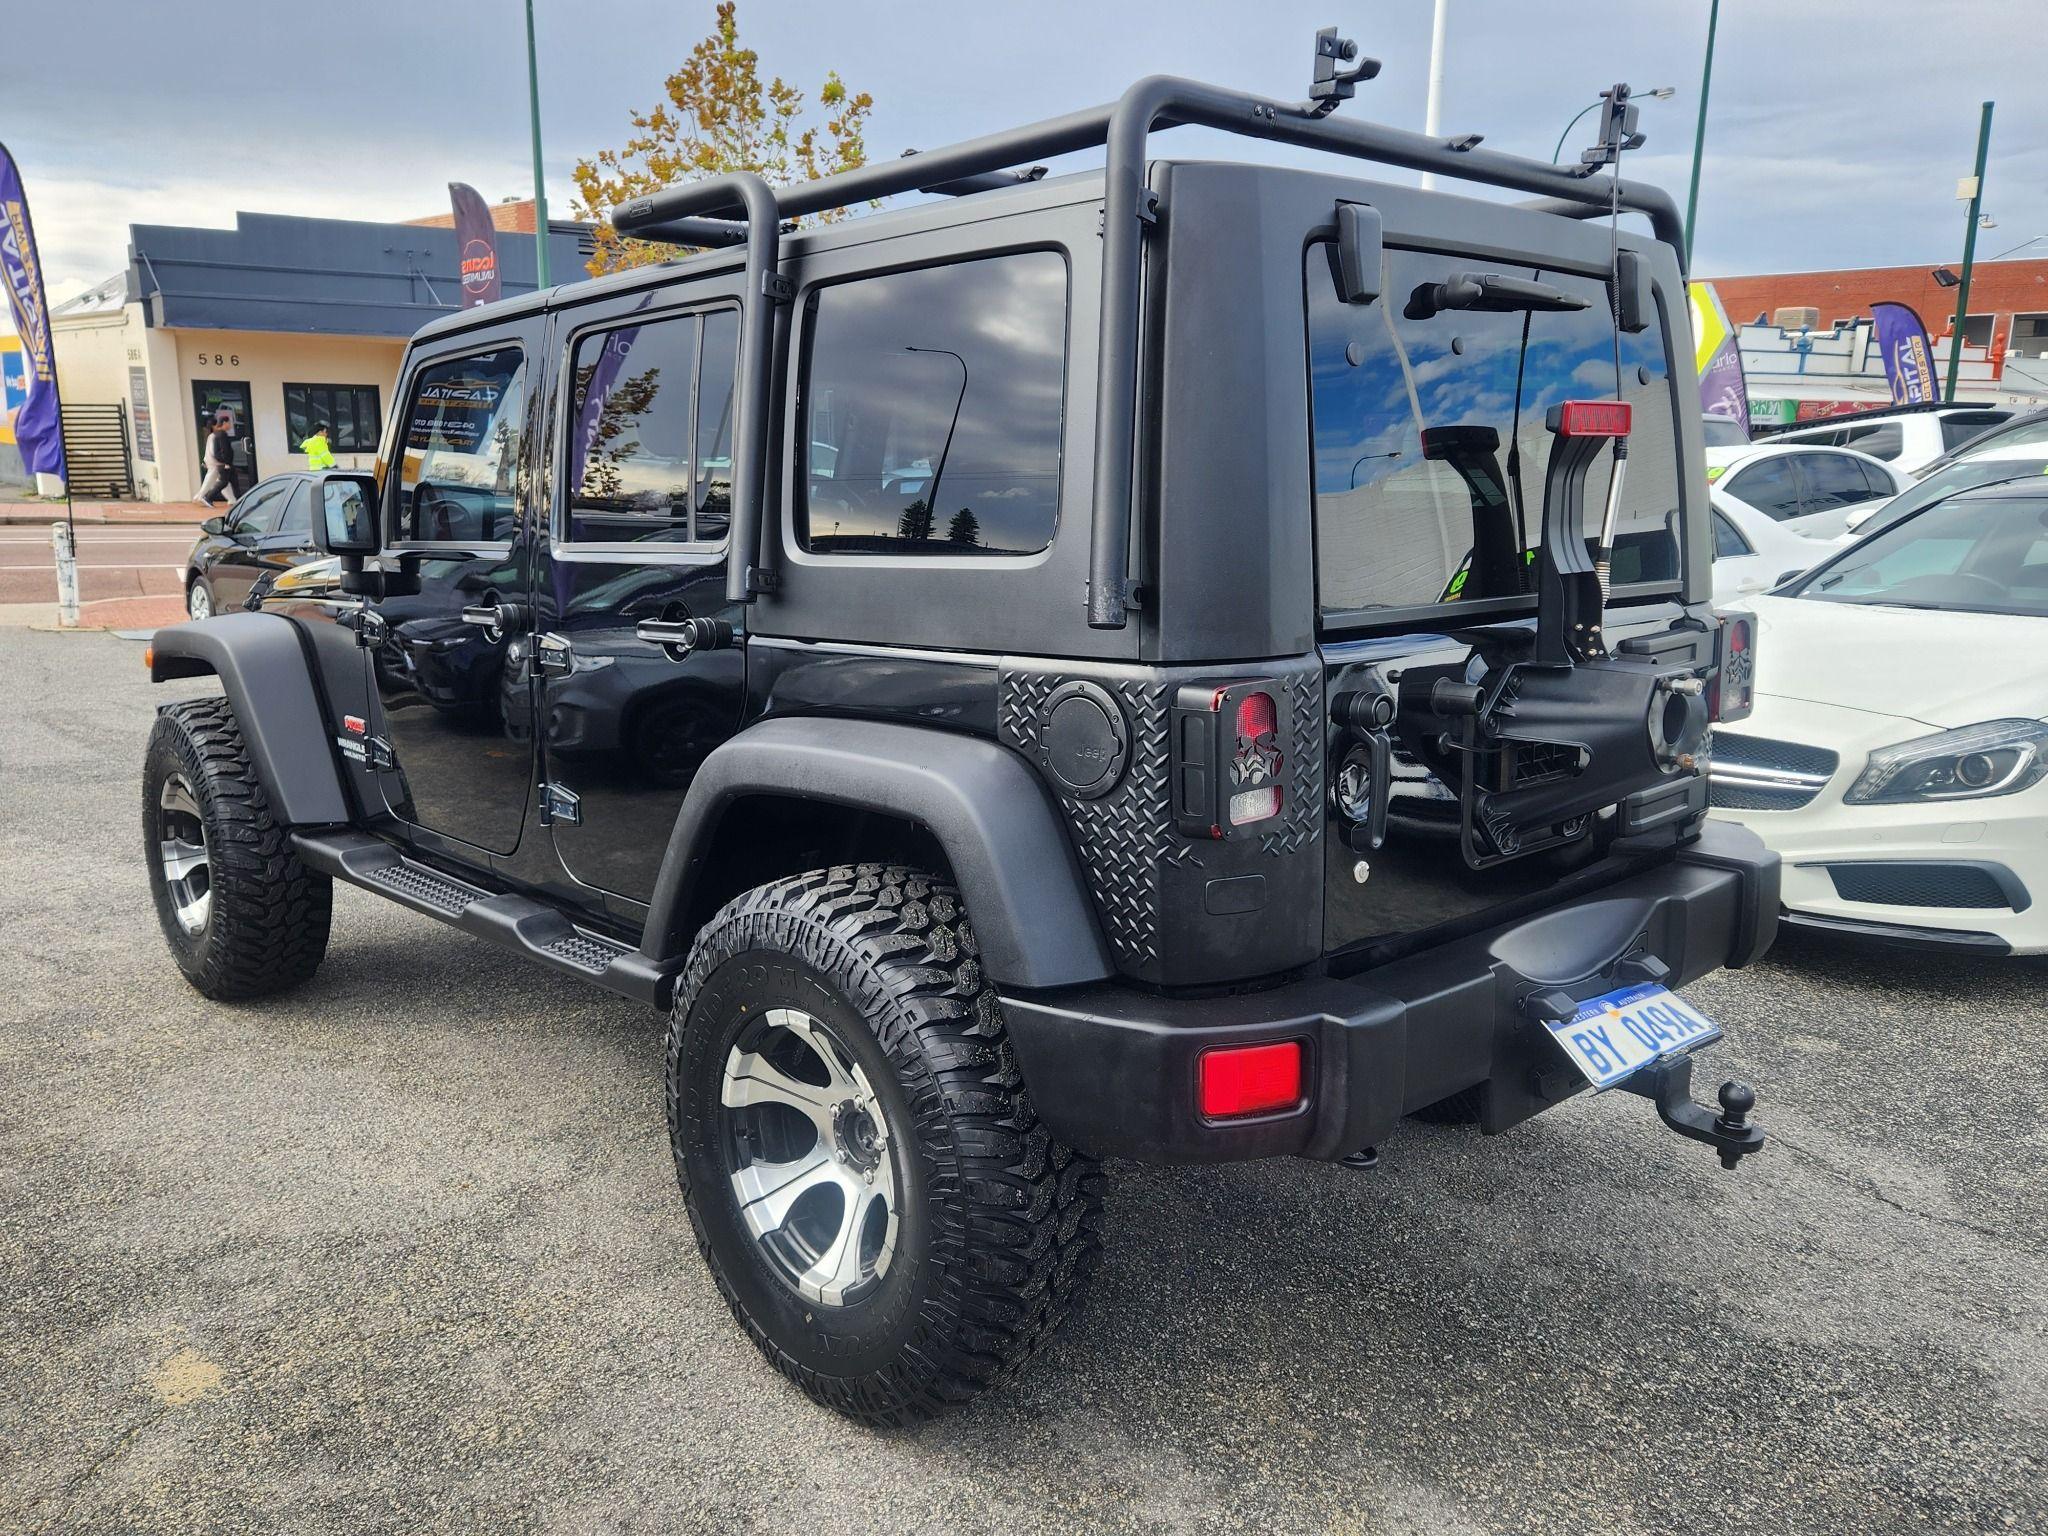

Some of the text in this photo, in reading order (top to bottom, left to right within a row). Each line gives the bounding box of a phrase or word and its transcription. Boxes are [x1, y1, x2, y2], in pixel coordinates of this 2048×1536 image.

[198, 352, 240, 367] 586
[1918, 360, 1932, 400] OTORS
[1075, 743, 1106, 762] Jeep
[1617, 992, 1646, 1006] AUSTRALIA
[1571, 1001, 1706, 1076] BY 049A
